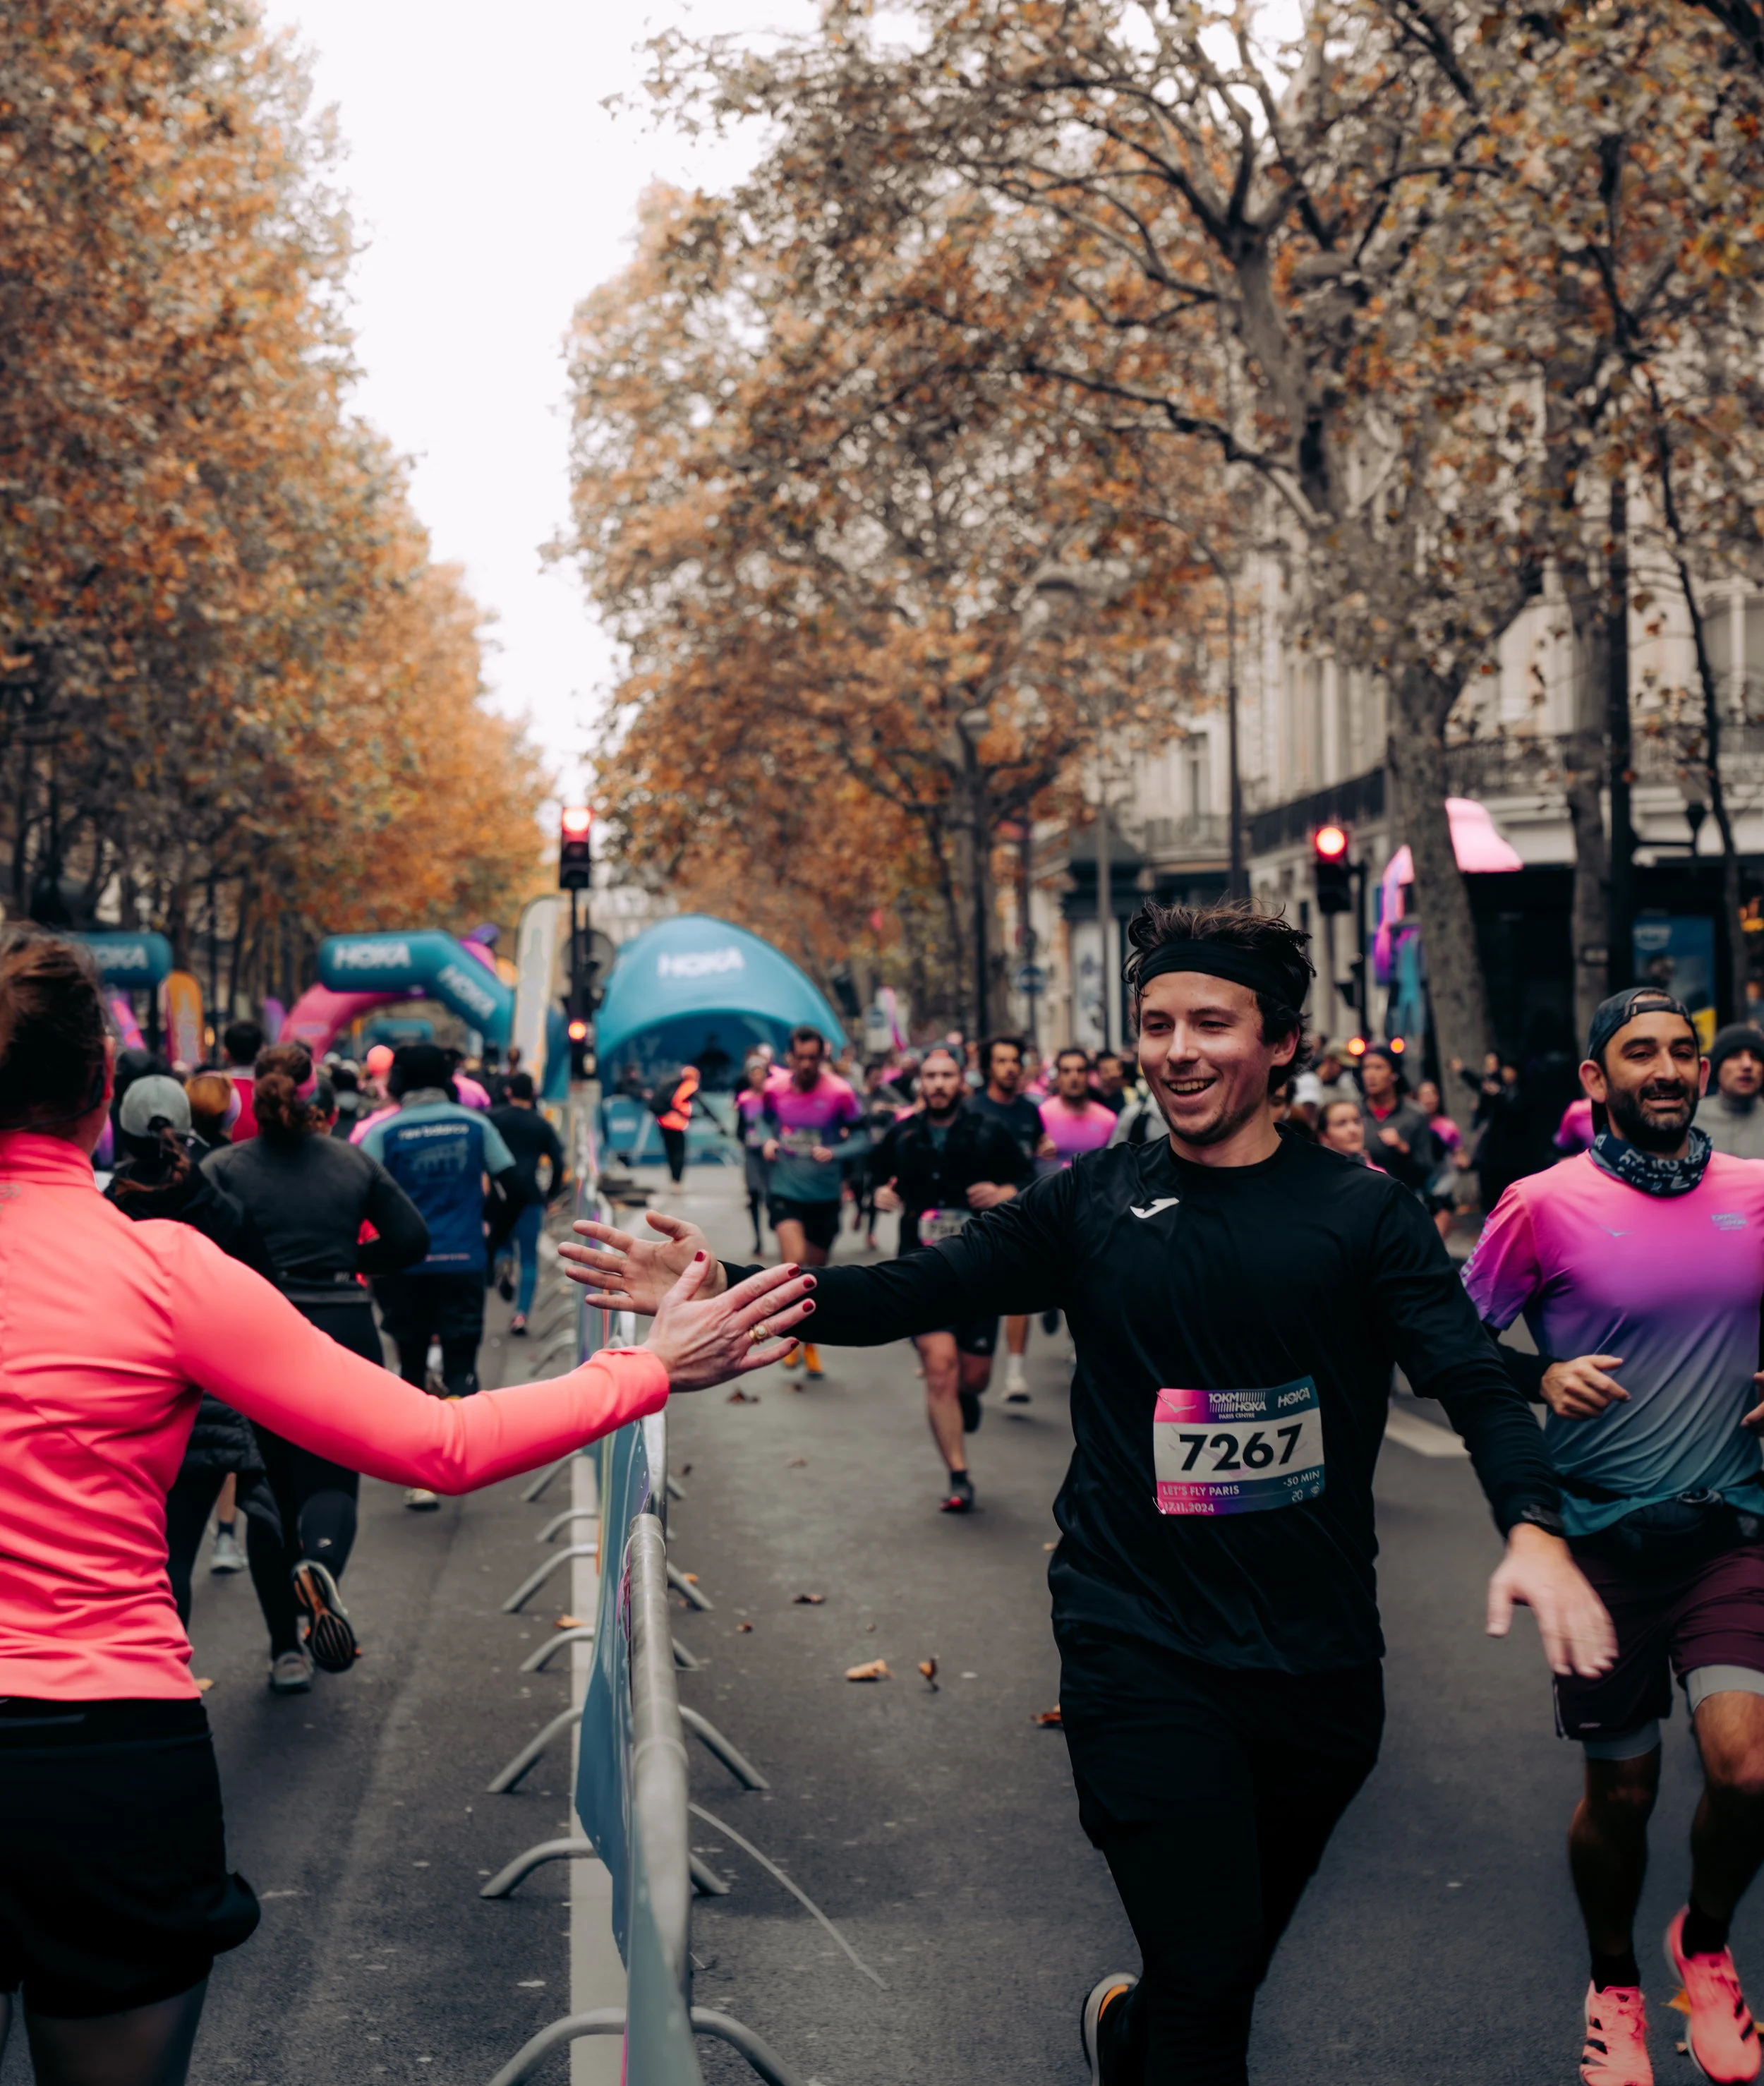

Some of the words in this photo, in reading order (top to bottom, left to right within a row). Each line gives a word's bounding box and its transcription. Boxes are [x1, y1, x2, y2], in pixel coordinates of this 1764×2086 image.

[95, 946, 148, 969] OKA
[333, 943, 412, 970] HOKA
[657, 947, 745, 977] HOKA
[1209, 1392, 1240, 1403] 10KM
[1236, 1401, 1267, 1411] HOKA
[1278, 1387, 1310, 1408] HOKA
[1179, 1423, 1303, 1471] 7267
[1301, 1470, 1319, 1483] MIN
[1163, 1485, 1188, 1495] LET'S
[1190, 1485, 1206, 1496] FLY
[1209, 1485, 1240, 1495] PARIS
[1164, 1501, 1214, 1513] 17.11.2024
